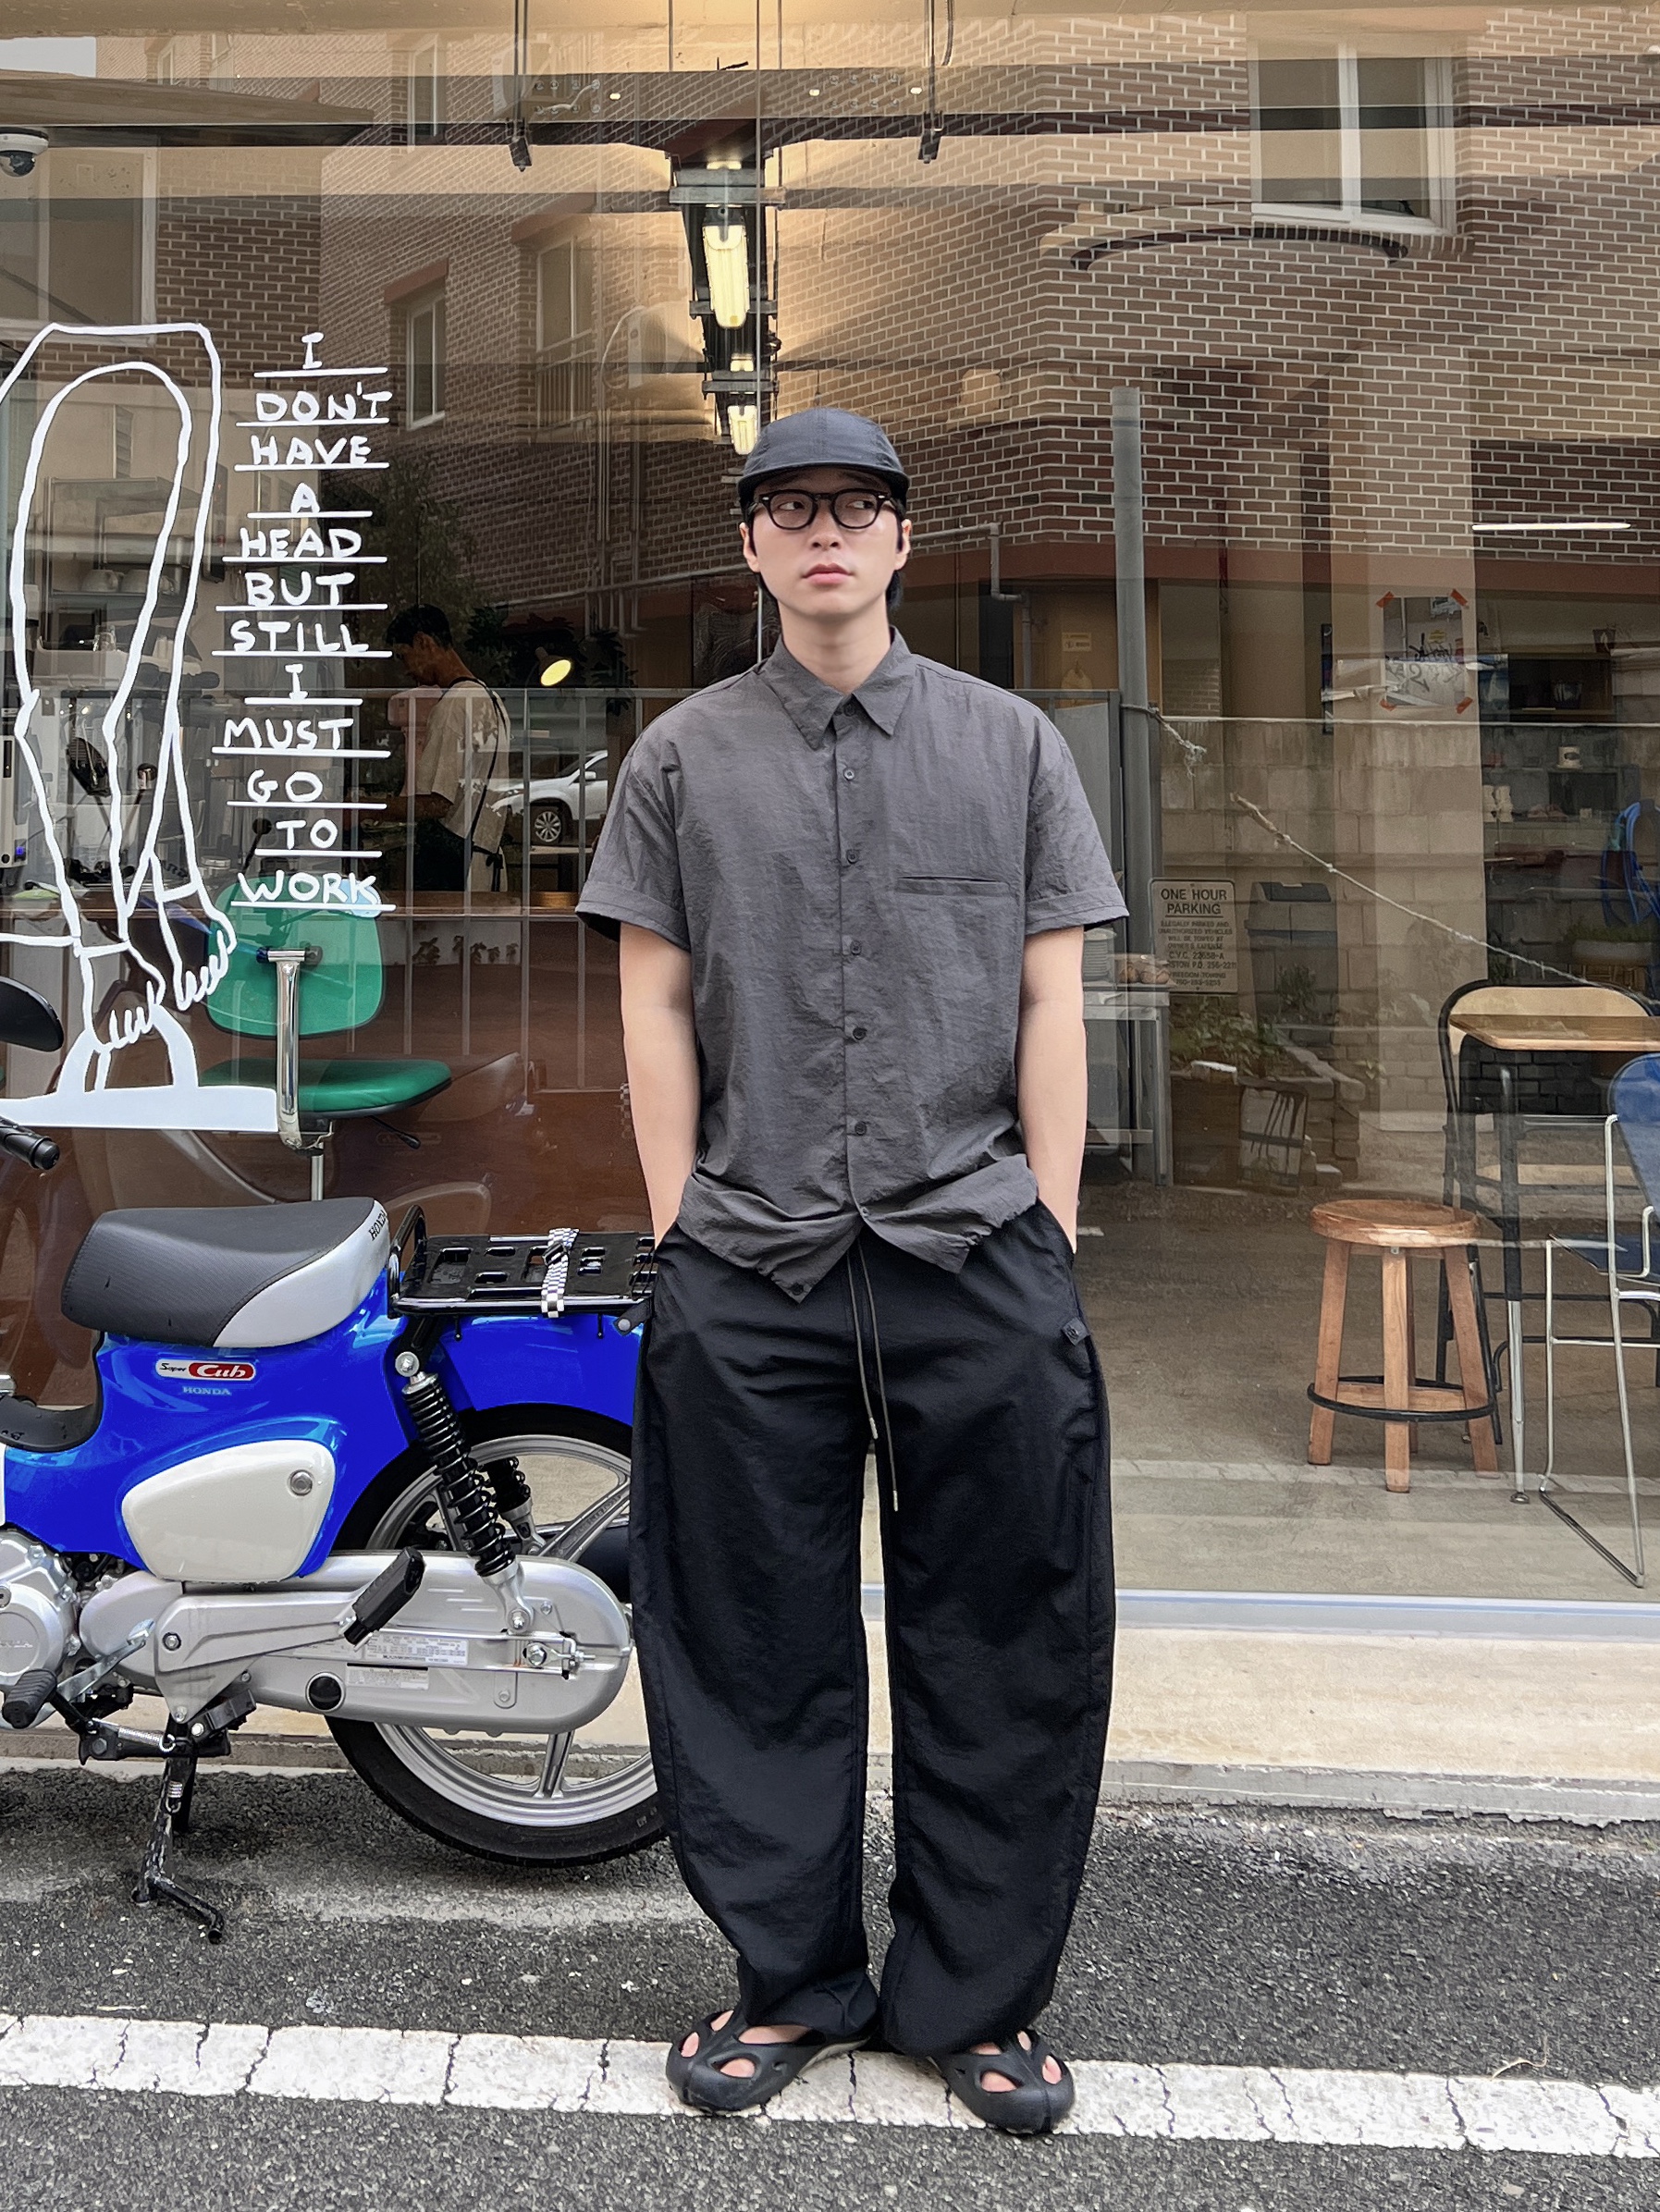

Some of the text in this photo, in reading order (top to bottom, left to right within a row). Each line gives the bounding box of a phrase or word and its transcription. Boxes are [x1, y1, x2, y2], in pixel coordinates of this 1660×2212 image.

[301, 331, 324, 370] I
[255, 381, 393, 422] DON'T
[251, 435, 371, 465] HAVE
[290, 482, 320, 513] A
[240, 527, 362, 558] HEAD
[244, 571, 355, 606] BUT
[230, 620, 369, 652] STILL
[284, 663, 309, 699] I
[223, 717, 354, 750] MUST
[247, 768, 324, 803] GO
[276, 818, 338, 849] TO
[237, 869, 377, 903] WORK
[1160, 888, 1228, 901] ONE HOUR
[1166, 903, 1222, 916] PARKING
[196, 1364, 246, 1378] Cub
[182, 1385, 232, 1396] HONDA
